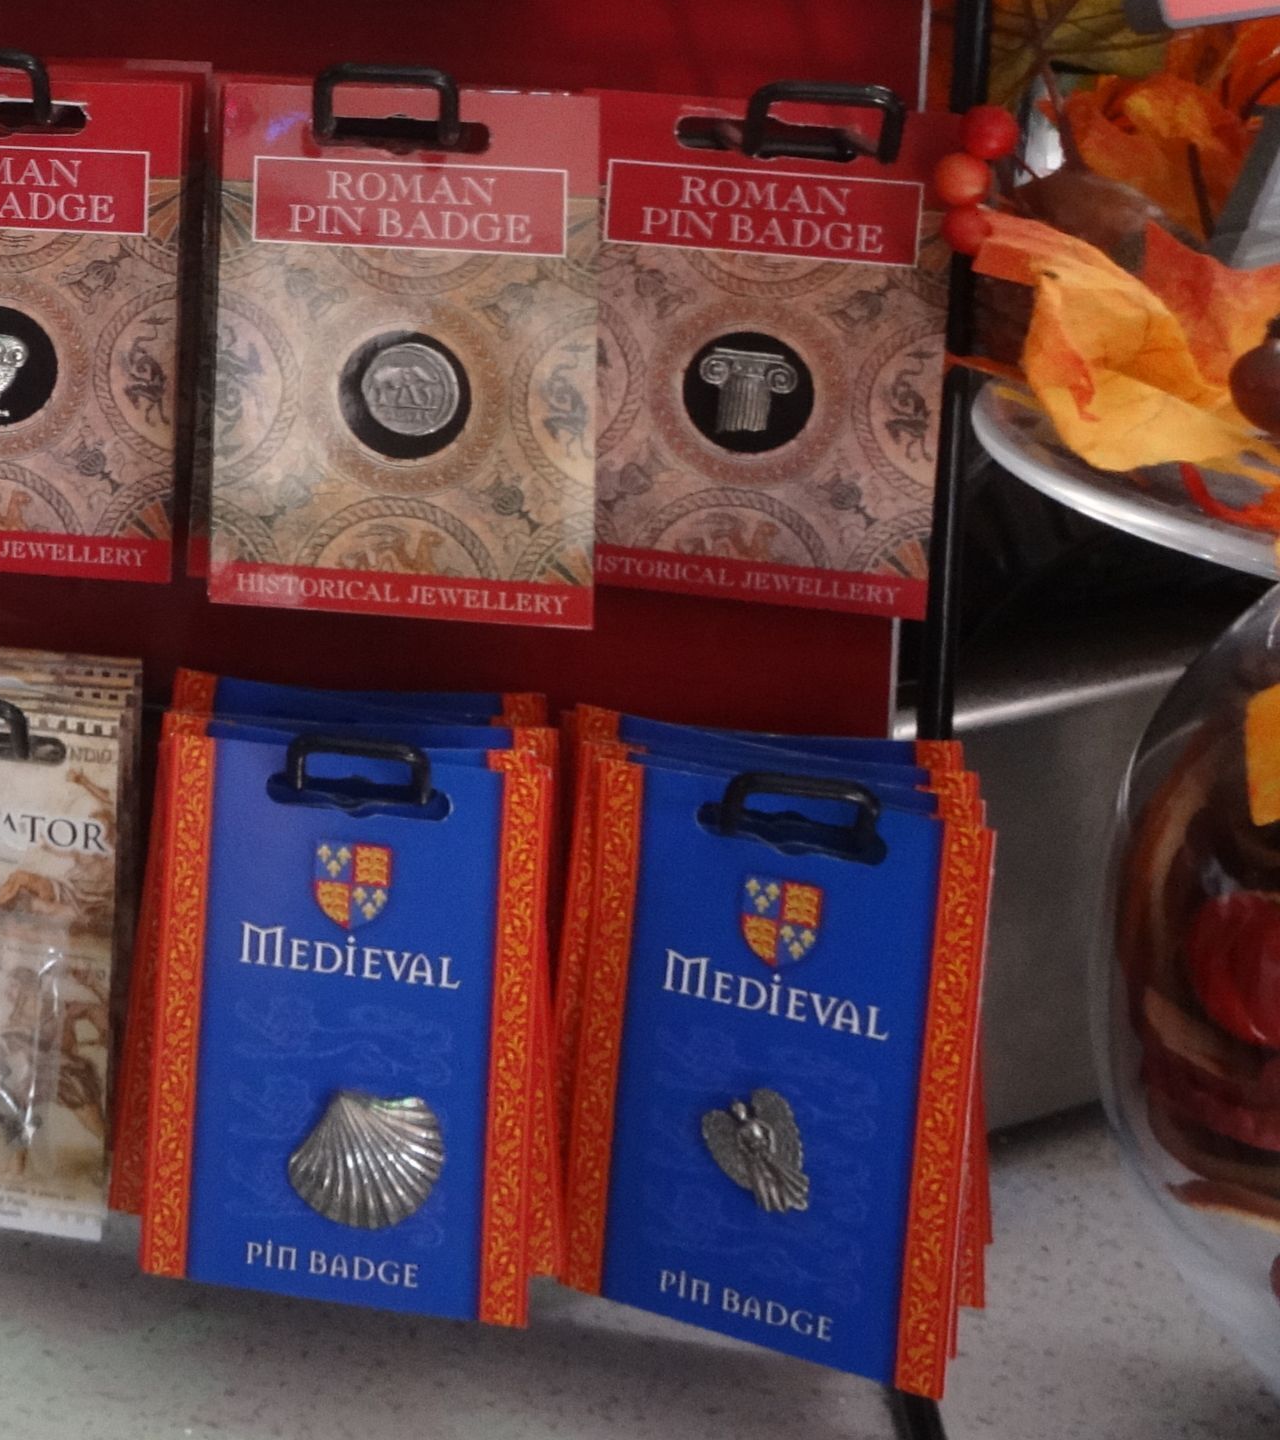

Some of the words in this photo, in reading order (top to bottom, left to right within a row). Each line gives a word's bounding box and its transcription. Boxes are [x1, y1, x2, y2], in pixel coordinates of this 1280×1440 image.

[326, 170, 495, 206] ROMAN
[680, 176, 850, 215] ROMAN
[288, 204, 366, 235] PIN
[376, 208, 533, 244] BADGE
[640, 207, 718, 238] PIN
[730, 214, 884, 254] BADGE
[237, 571, 400, 603] HISTORICAL
[407, 577, 570, 616] JEWELLERY
[596, 553, 736, 587] ISTORICAL
[741, 569, 902, 607] JEWELLERY
[246, 1240, 301, 1272] PIN
[308, 1249, 420, 1290] BADGE
[659, 1267, 711, 1307] PIN
[722, 1289, 833, 1343] BADGE
